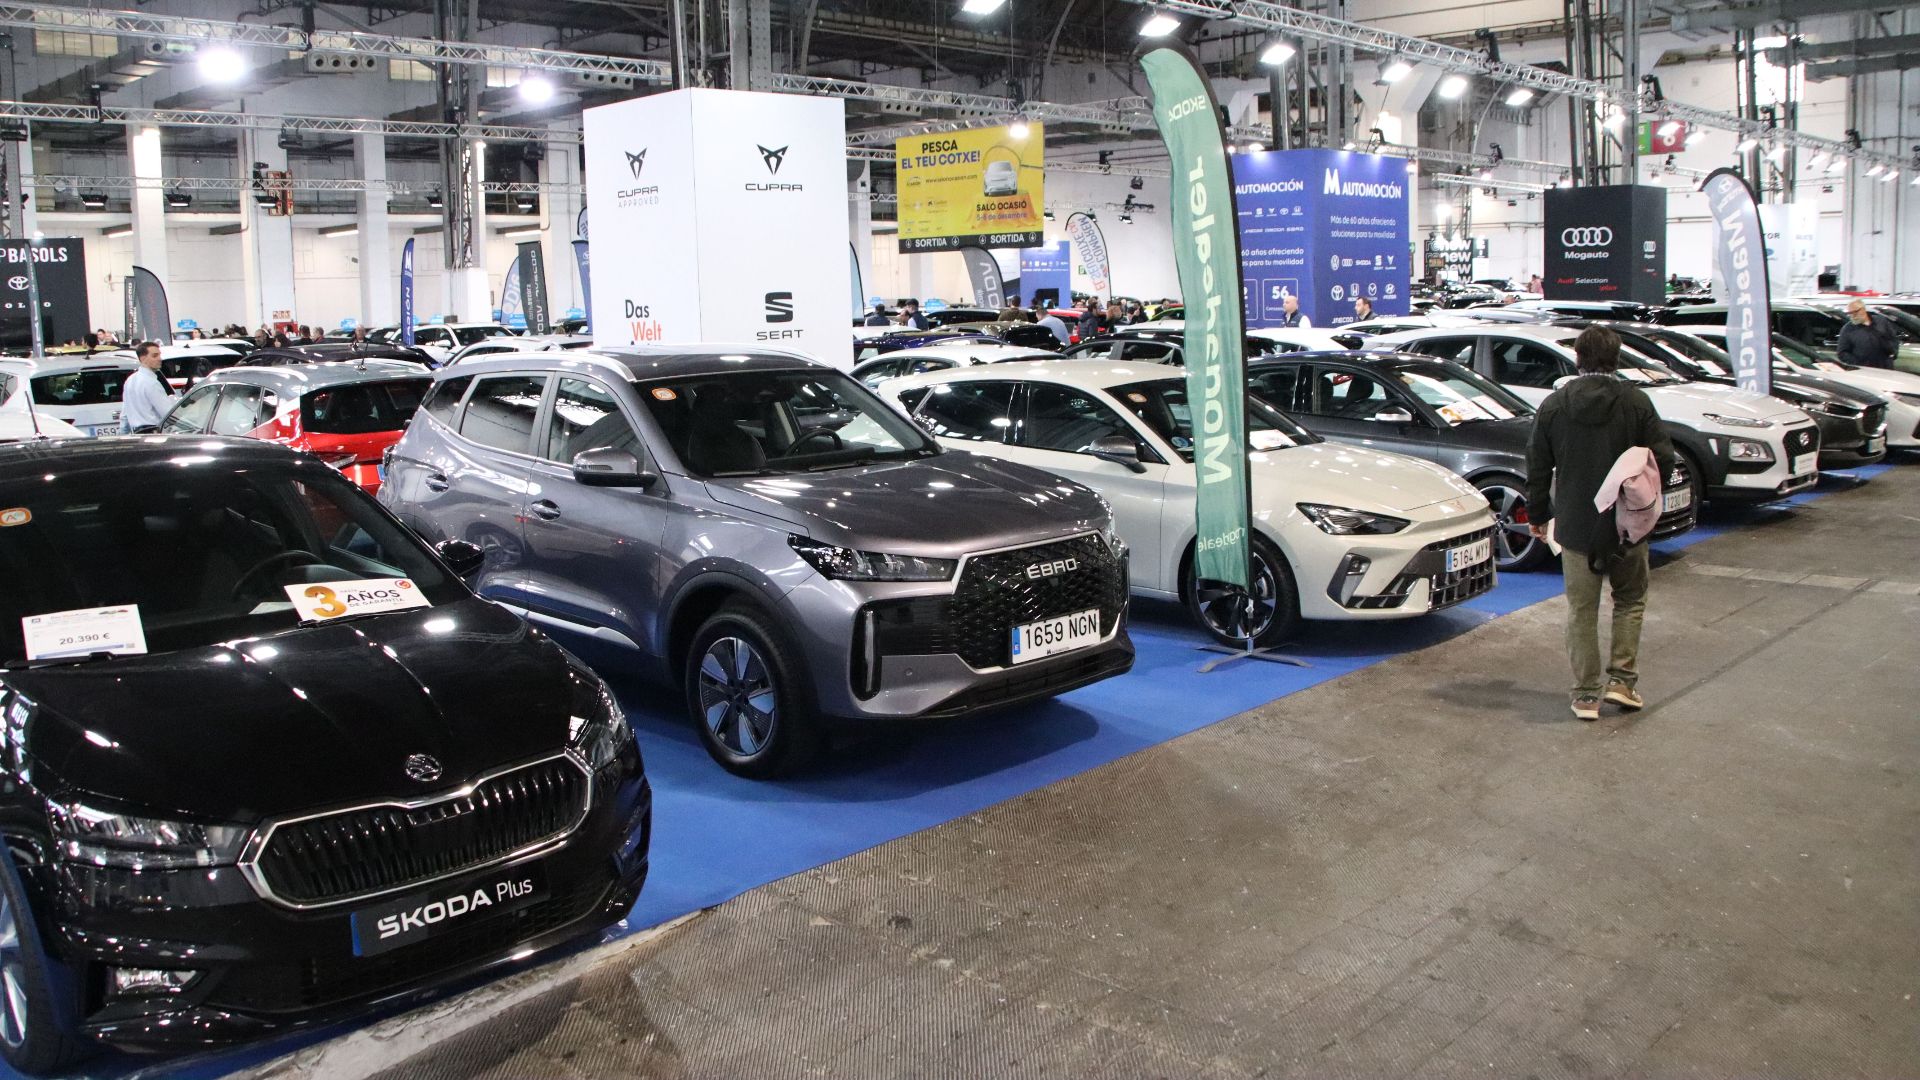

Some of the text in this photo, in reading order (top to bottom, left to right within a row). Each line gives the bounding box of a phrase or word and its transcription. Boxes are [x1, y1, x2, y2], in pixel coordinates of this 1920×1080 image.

[922, 140, 958, 154] PESCA
[901, 150, 981, 169] EL TEU COTXE!
[618, 186, 659, 198] CUPRA
[745, 183, 803, 192] CUPRA
[1235, 178, 1304, 194] AUTOMOCIÓN
[1342, 181, 1401, 199] AUTOMOCIÓN
[618, 196, 660, 208] APPROVED
[976, 199, 1027, 211] SALÓ OCASIÓ
[997, 212, 1027, 220] desembre
[915, 233, 1025, 248] SORTIDA SORTIDA
[1250, 248, 1267, 256] años
[1268, 247, 1304, 256] ofreciendo
[1564, 251, 1609, 260] Mogauto
[1271, 285, 1289, 299] 56
[625, 299, 650, 319] Das
[632, 319, 662, 341] Welt
[756, 329, 804, 341] SEAT
[1453, 547, 1473, 568] 5164
[1026, 558, 1077, 579] EBRO
[304, 585, 401, 618] 3 AÑOS
[1025, 613, 1097, 649] 1659 NGN
[59, 632, 110, 645] 20.390 €
[377, 878, 533, 940] SKODA Plus
